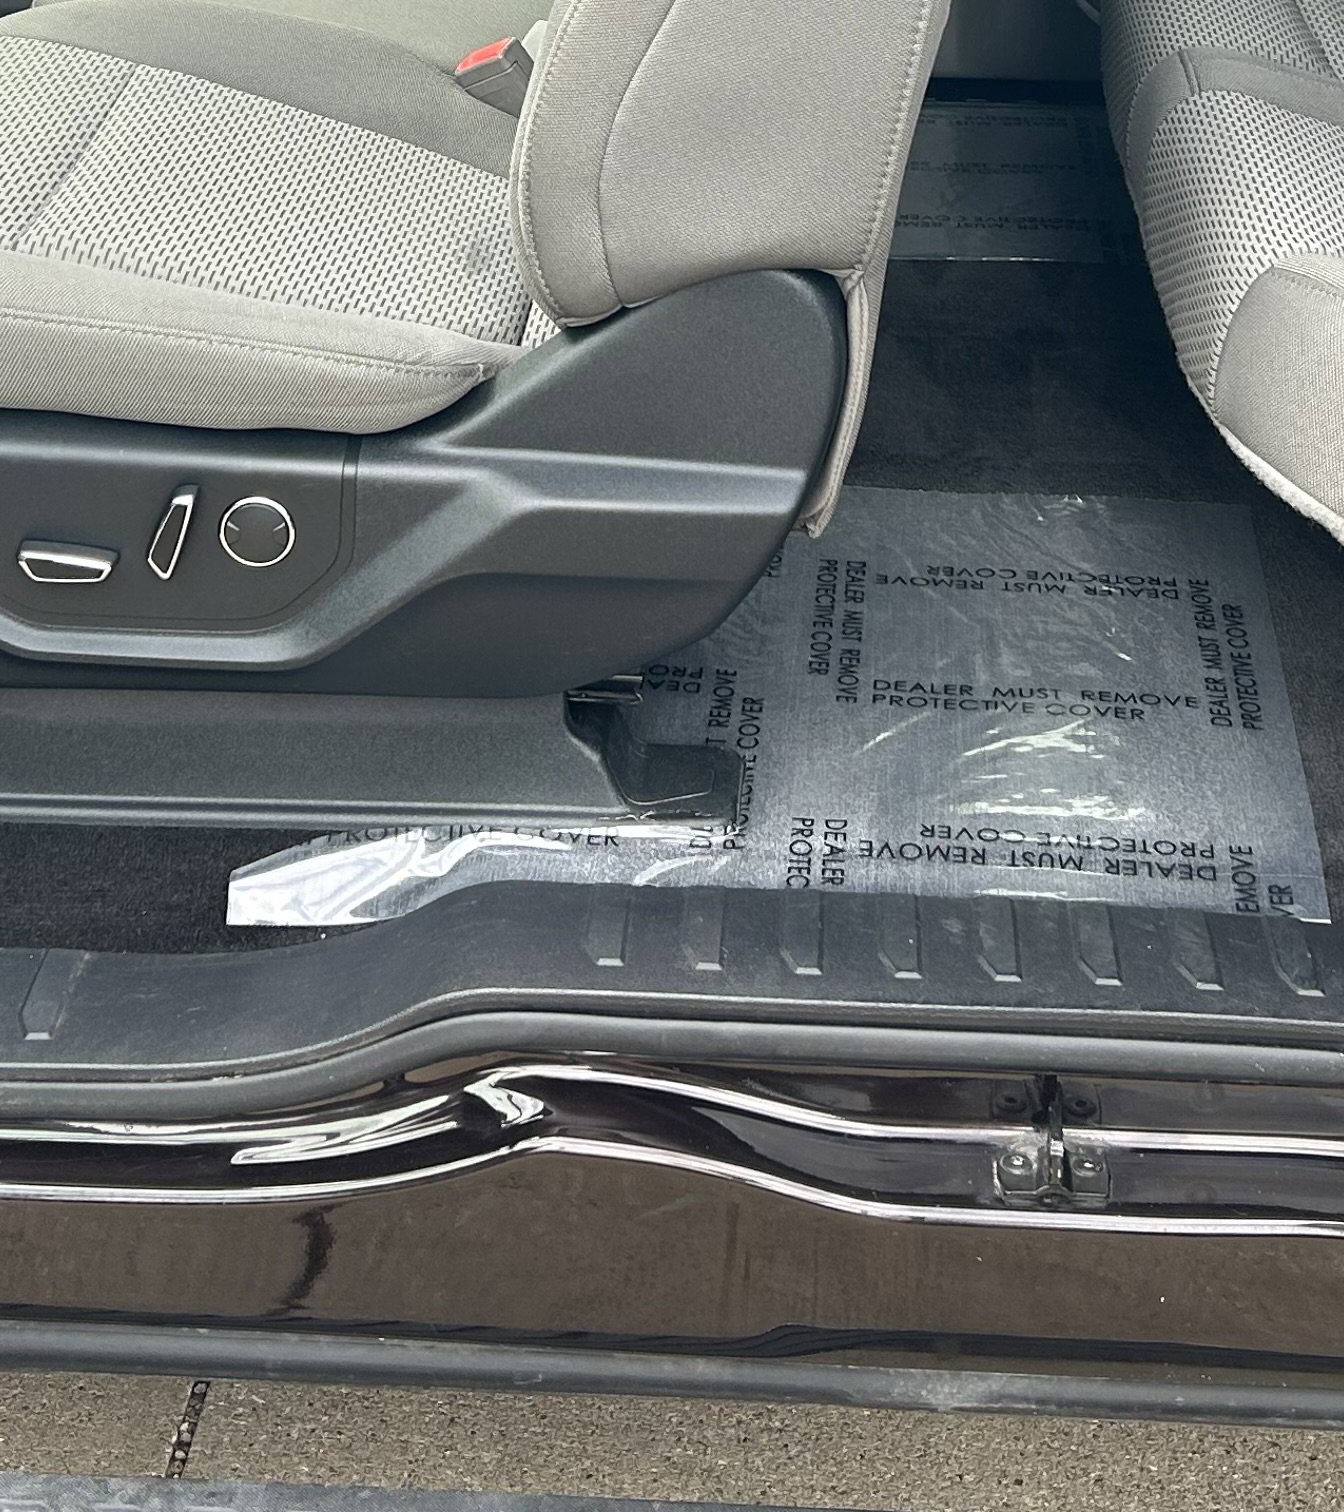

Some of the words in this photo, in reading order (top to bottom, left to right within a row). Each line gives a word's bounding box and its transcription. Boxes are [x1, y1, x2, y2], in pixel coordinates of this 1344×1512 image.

[843, 559, 867, 605] DEALER
[875, 572, 985, 590] REMOVE
[926, 563, 1017, 579] COVER
[1001, 580, 1068, 595] MUST
[1026, 568, 1178, 587] PROTECTIVE
[811, 557, 839, 629] PROTECTIVE
[1187, 578, 1218, 636] REMOVE
[840, 608, 865, 646] MUST
[1222, 603, 1255, 647] COVER
[806, 626, 833, 677] COVER
[1199, 635, 1224, 675] MUST
[835, 647, 862, 705] REMOVE
[871, 679, 974, 697] DEALER
[992, 687, 1063, 701] MUST
[1080, 689, 1199, 710] REMOVE
[1229, 647, 1263, 731] PROTECTIVE
[707, 668, 738, 728] REMOVE
[871, 693, 1034, 715] PROTECTIVE
[1045, 702, 1147, 722] COVER
[1205, 676, 1234, 729] DEALER
[736, 696, 765, 750] COVER
[786, 816, 815, 888] PROTEC
[821, 817, 849, 886] DEALER
[856, 838, 988, 866] REMOVE
[919, 822, 1031, 843] COVER
[1035, 832, 1215, 859] PROTECTIVE
[1005, 850, 1084, 872] MUST
[1105, 857, 1219, 882] DEALER
[1229, 843, 1259, 914] EMOVE
